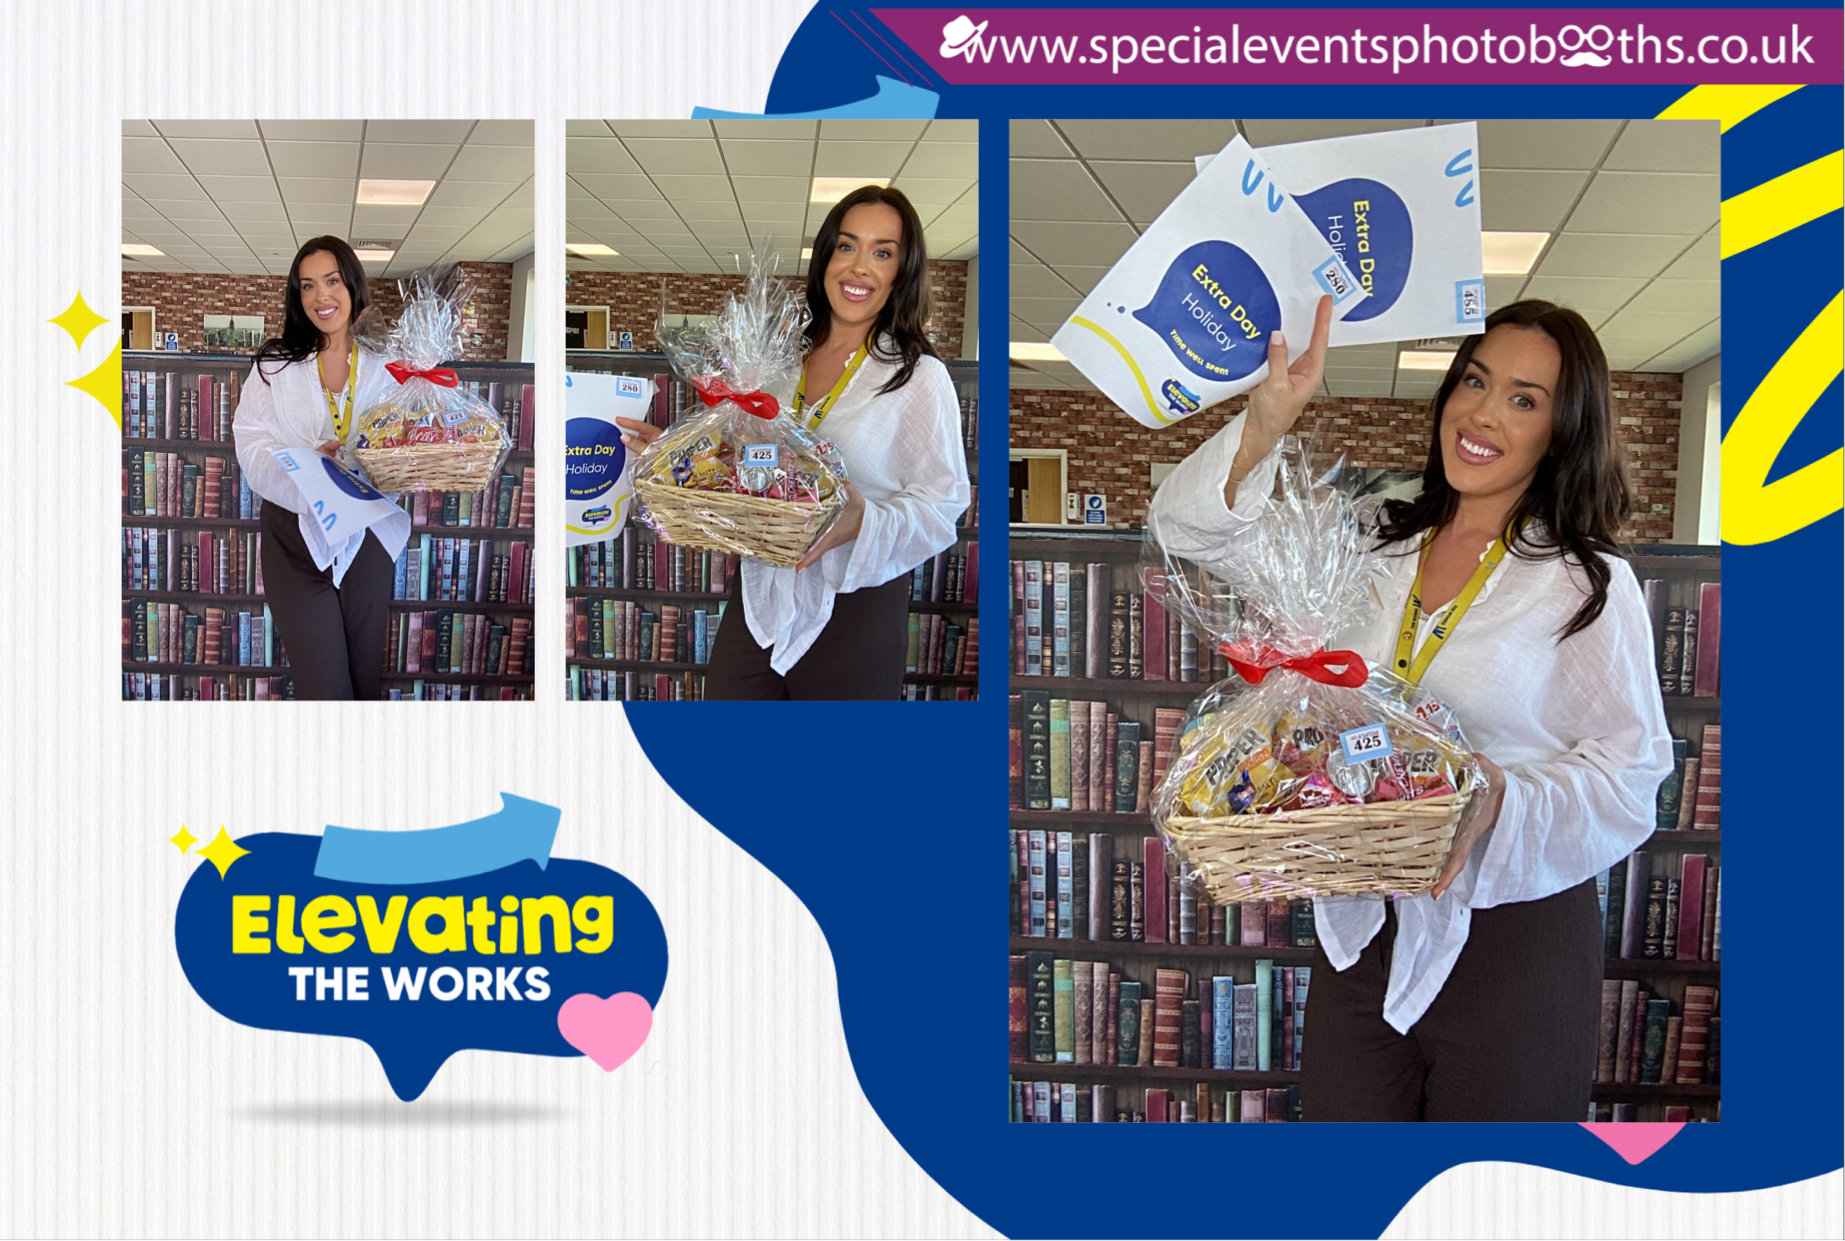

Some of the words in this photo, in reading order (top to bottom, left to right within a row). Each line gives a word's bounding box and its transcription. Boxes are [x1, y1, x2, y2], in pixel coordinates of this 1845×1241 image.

[1353, 200, 1371, 253] Extra
[1325, 270, 1346, 295] 280
[1359, 258, 1376, 297] Day
[1191, 263, 1232, 309] Extra
[1230, 304, 1262, 340] Day
[1464, 290, 1475, 316] 485
[1181, 292, 1237, 352] Holiday
[622, 384, 638, 393] 280
[594, 444, 616, 457] Day
[752, 451, 772, 460] 425
[566, 462, 608, 475] Holiday
[1353, 735, 1382, 751] 425
